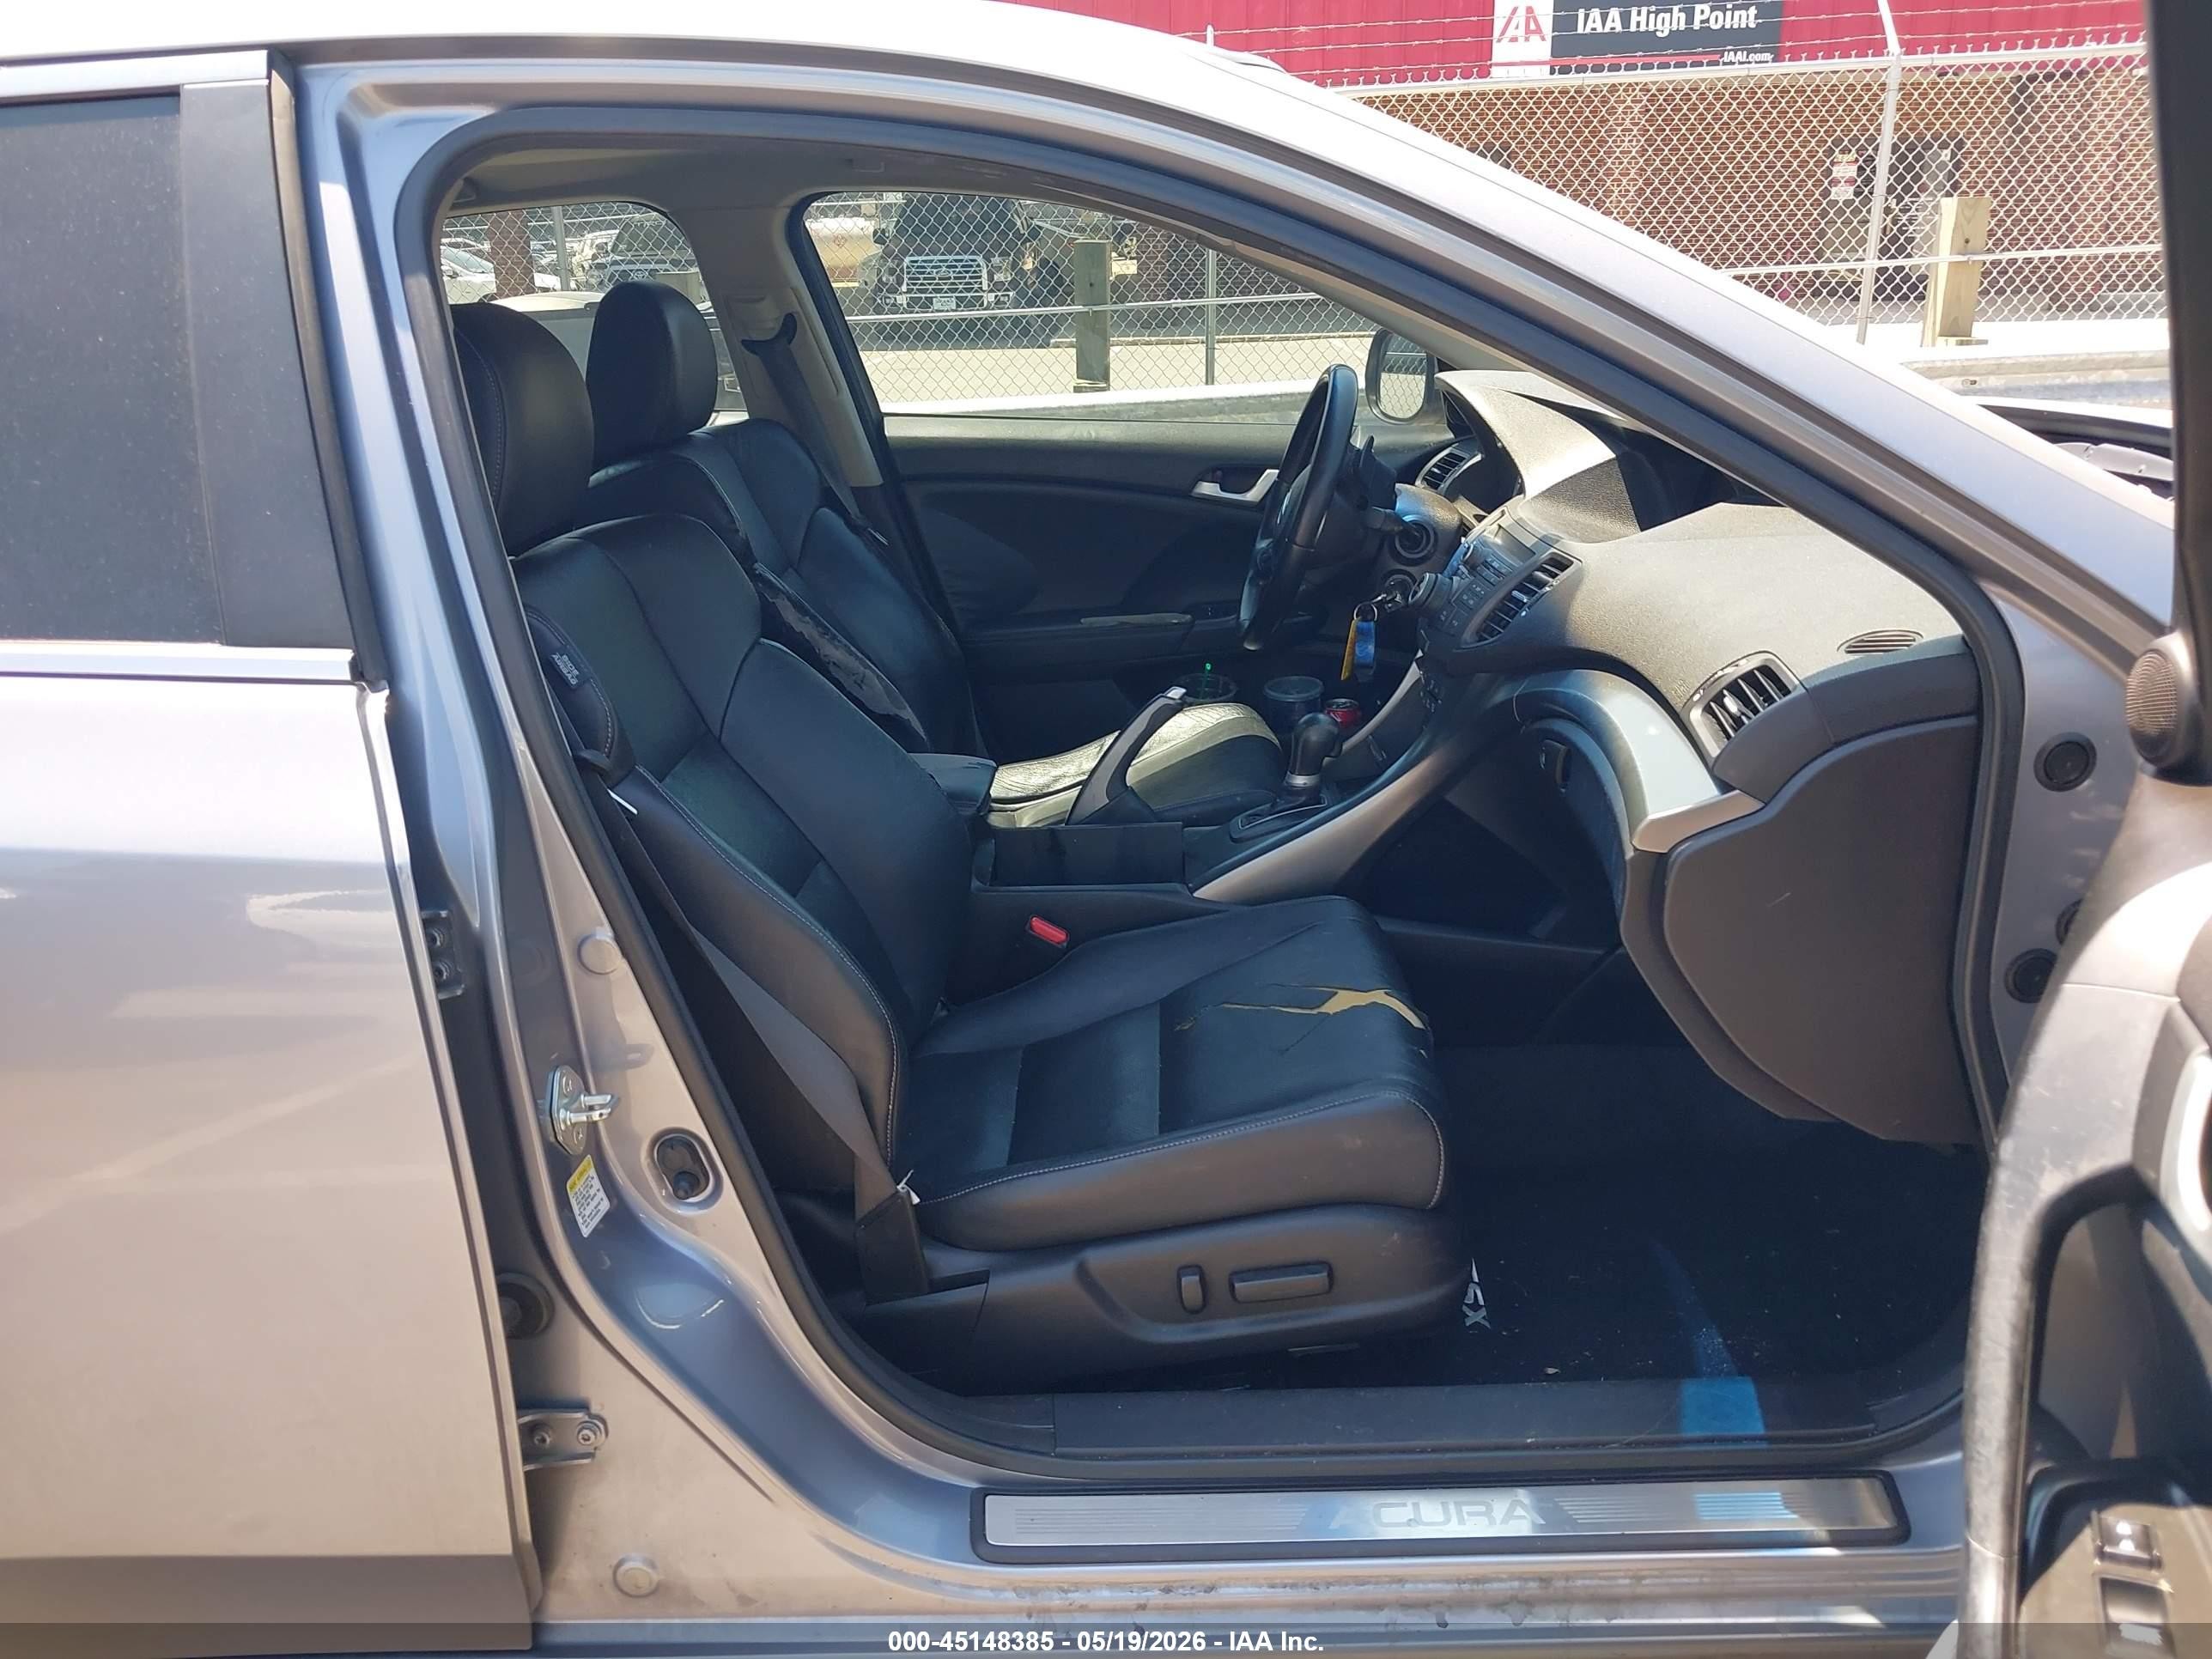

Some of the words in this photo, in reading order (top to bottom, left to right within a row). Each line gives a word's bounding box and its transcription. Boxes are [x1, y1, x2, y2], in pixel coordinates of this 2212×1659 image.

[1577, 8, 1623, 33] IAA
[1630, 5, 1686, 38] High
[1693, 4, 1758, 30] Point
[1723, 51, 1772, 64] IAAI.com
